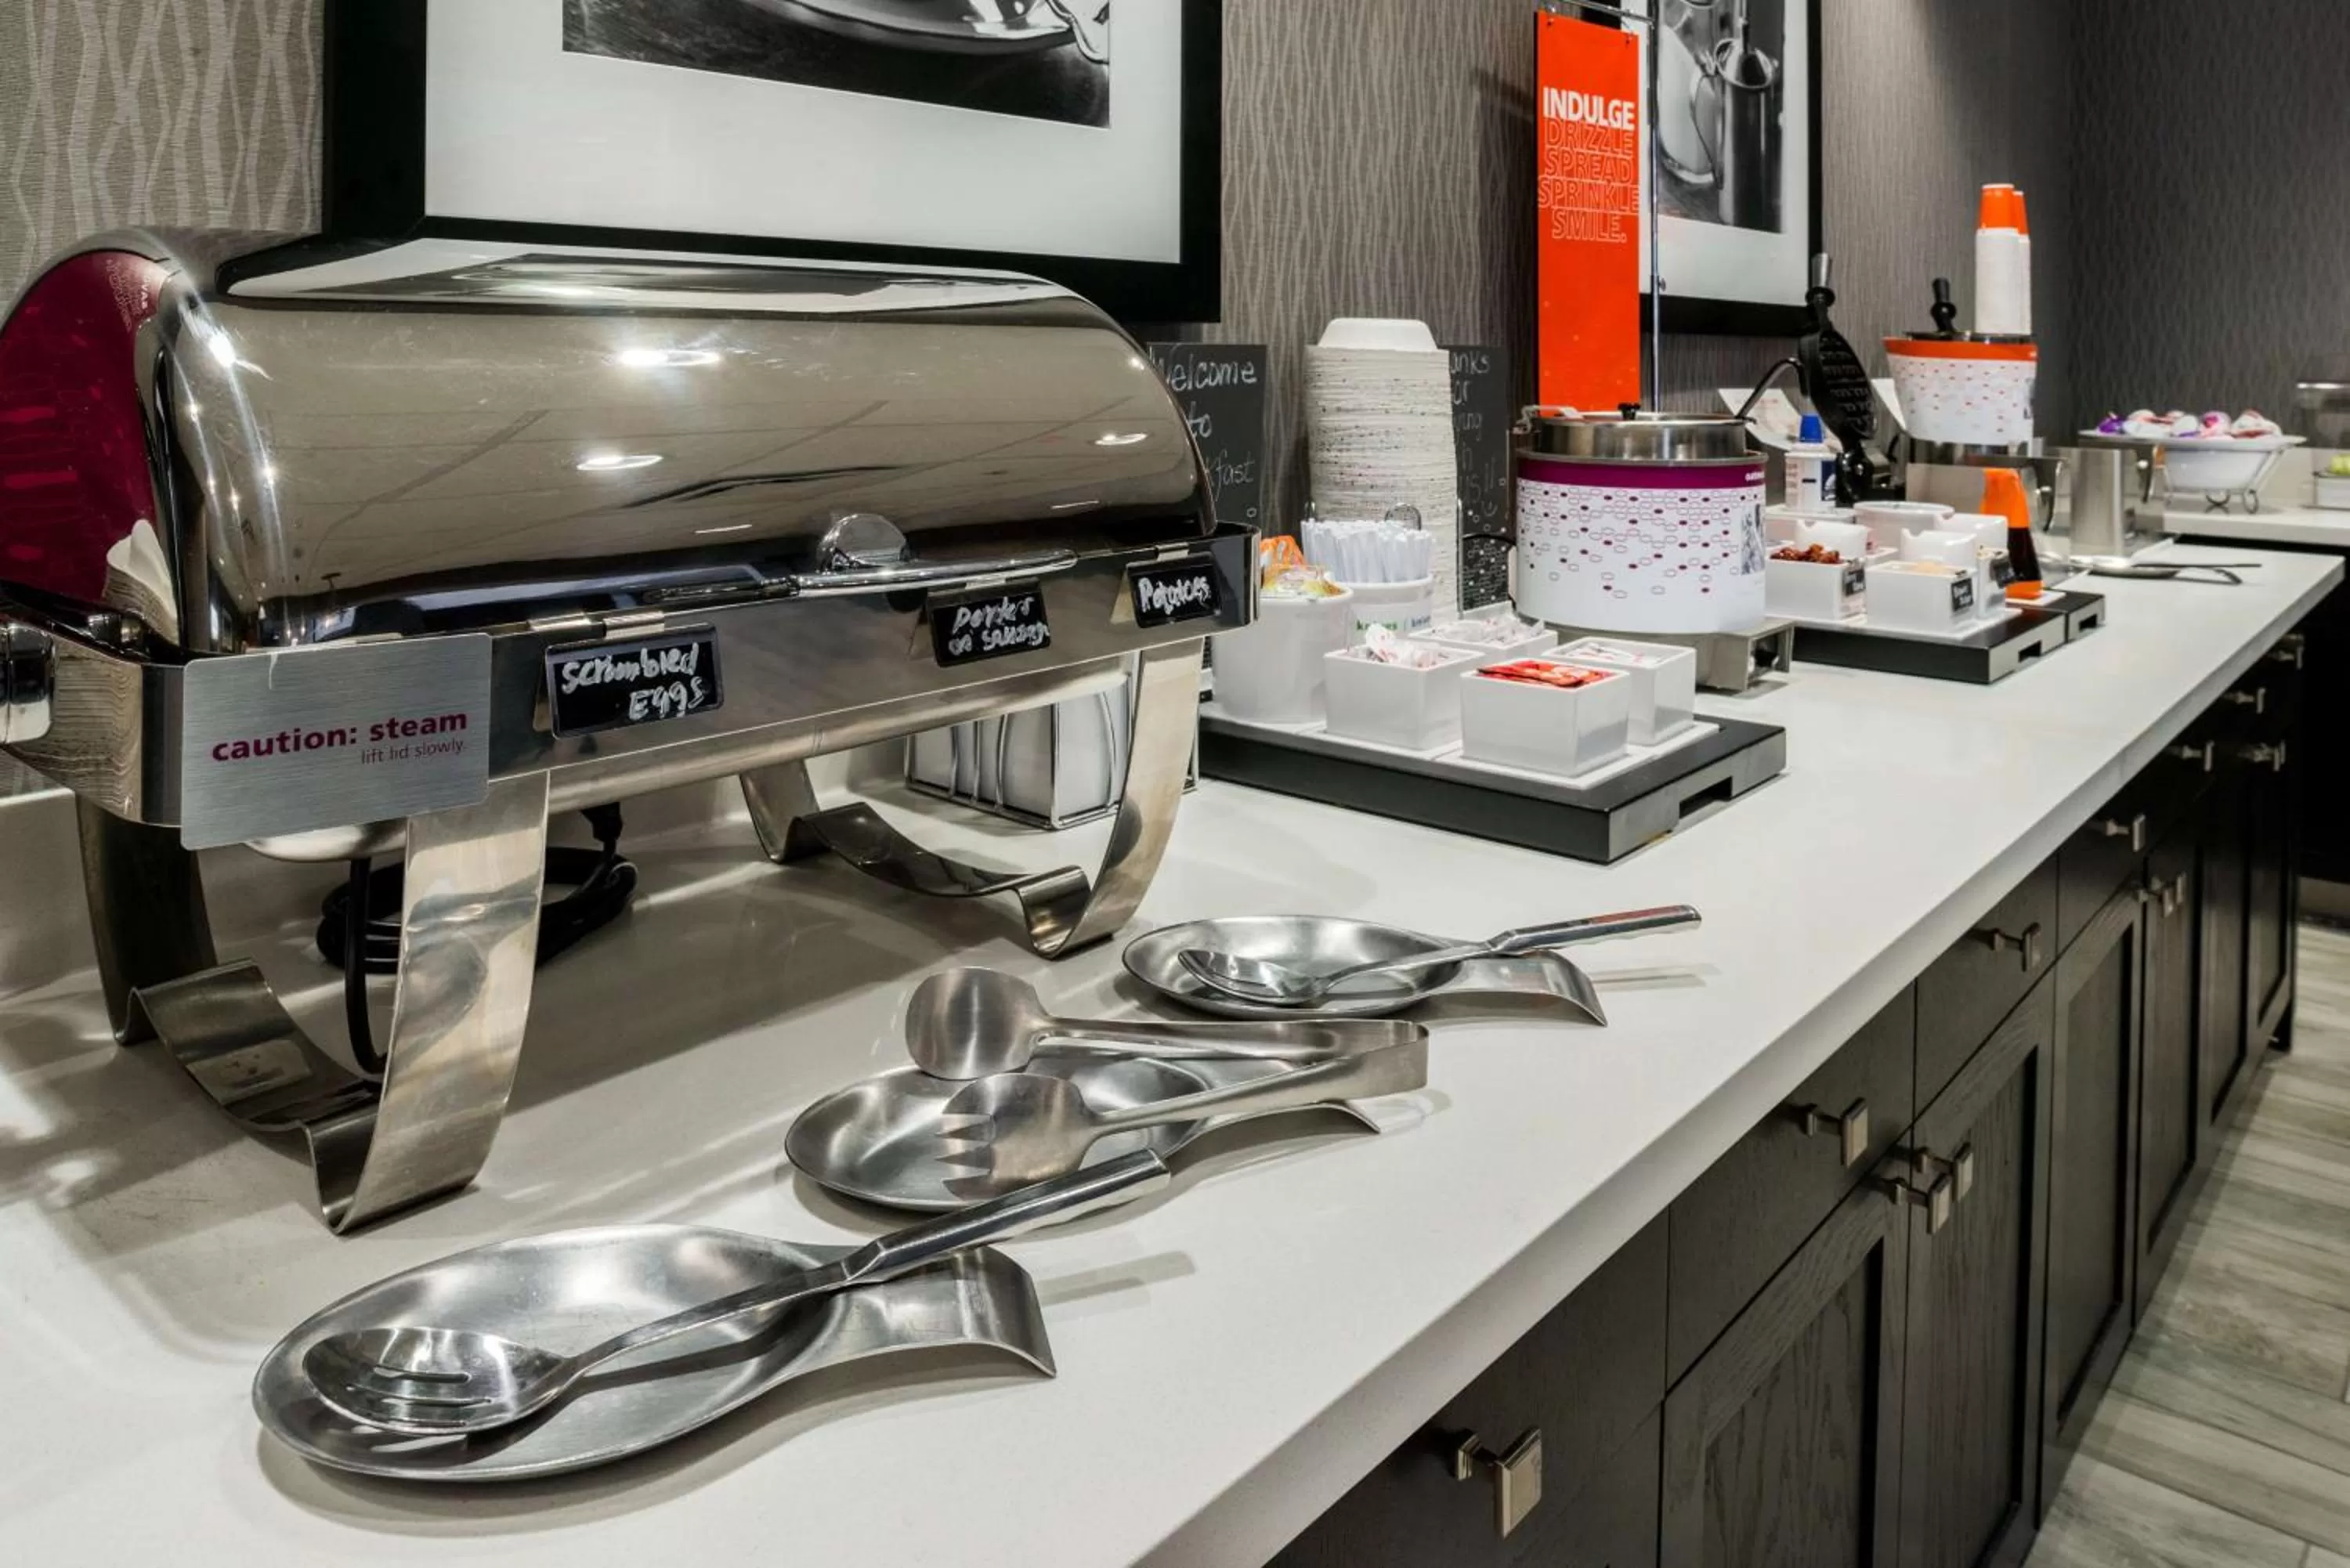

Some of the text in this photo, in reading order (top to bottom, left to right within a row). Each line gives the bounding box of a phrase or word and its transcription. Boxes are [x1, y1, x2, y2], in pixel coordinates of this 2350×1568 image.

[1542, 87, 1635, 132] INDULGE
[1545, 117, 1633, 157] DRIZZLE
[1545, 146, 1633, 184] SPREAD
[1538, 175, 1640, 215] SPRINKLE
[1450, 350, 1491, 374] anks
[1188, 400, 1212, 439] to
[212, 712, 467, 761] caution: steam
[361, 748, 385, 764] lift
[390, 743, 408, 761] lid
